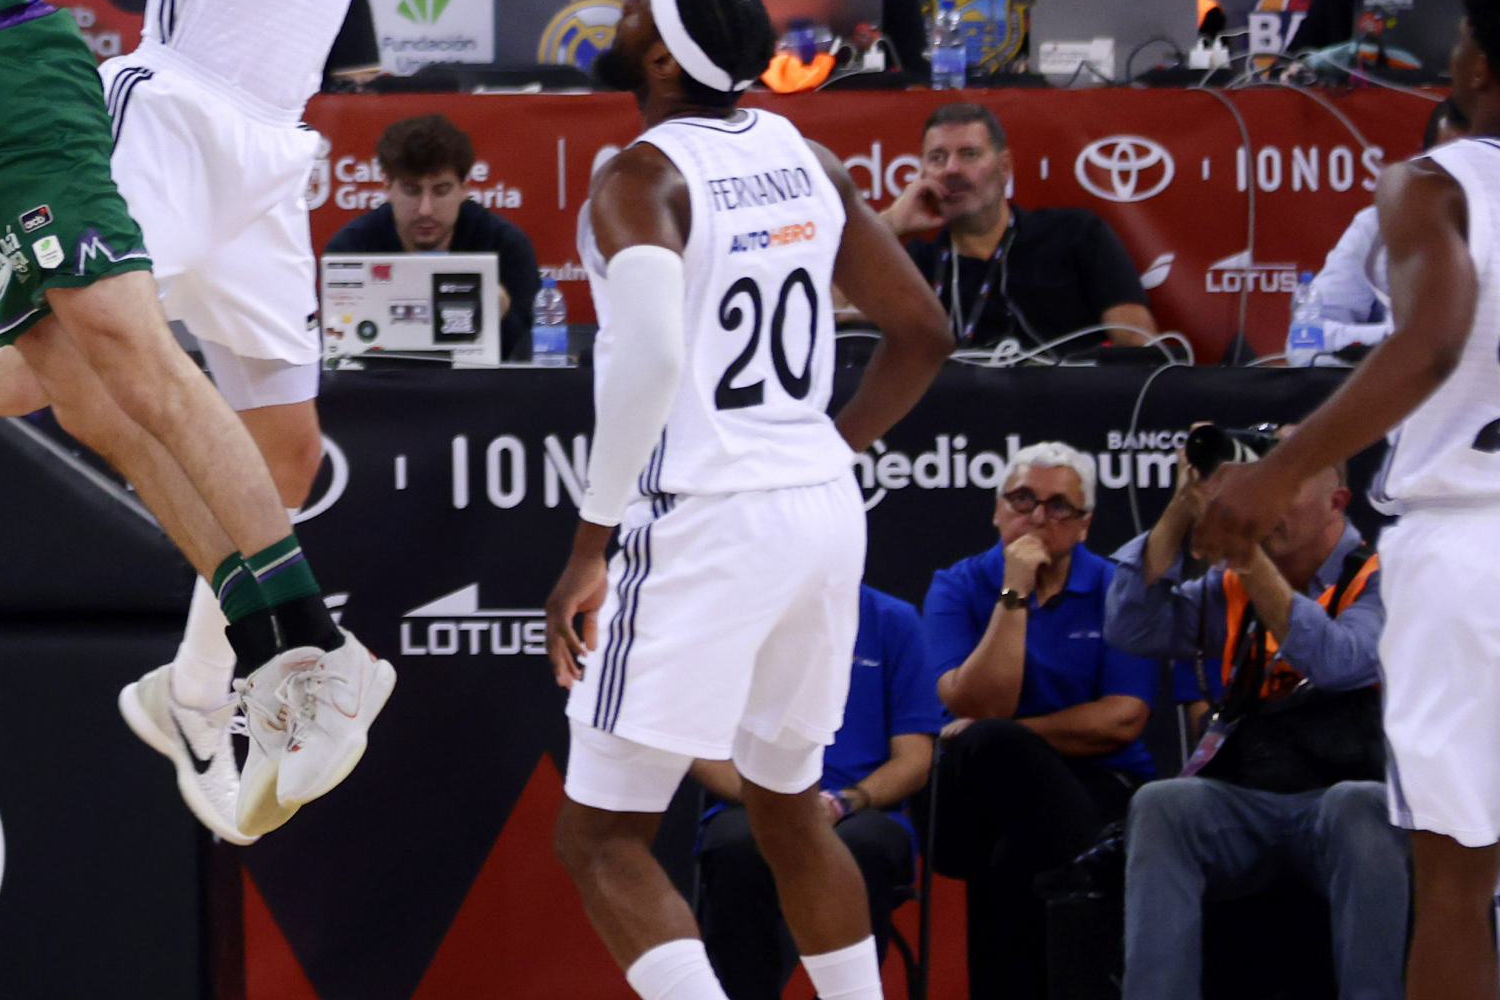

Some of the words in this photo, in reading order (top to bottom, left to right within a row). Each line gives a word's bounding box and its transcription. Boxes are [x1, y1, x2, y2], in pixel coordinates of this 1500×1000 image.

[706, 166, 814, 212] FERNANDO
[1237, 146, 1386, 192] IONOS
[729, 221, 817, 256] AUTOHERO
[1205, 271, 1298, 294] LOTUS
[714, 267, 818, 411] 20
[1107, 430, 1188, 452] BANCO
[451, 434, 587, 509] ION
[401, 622, 548, 657] LOTUS
